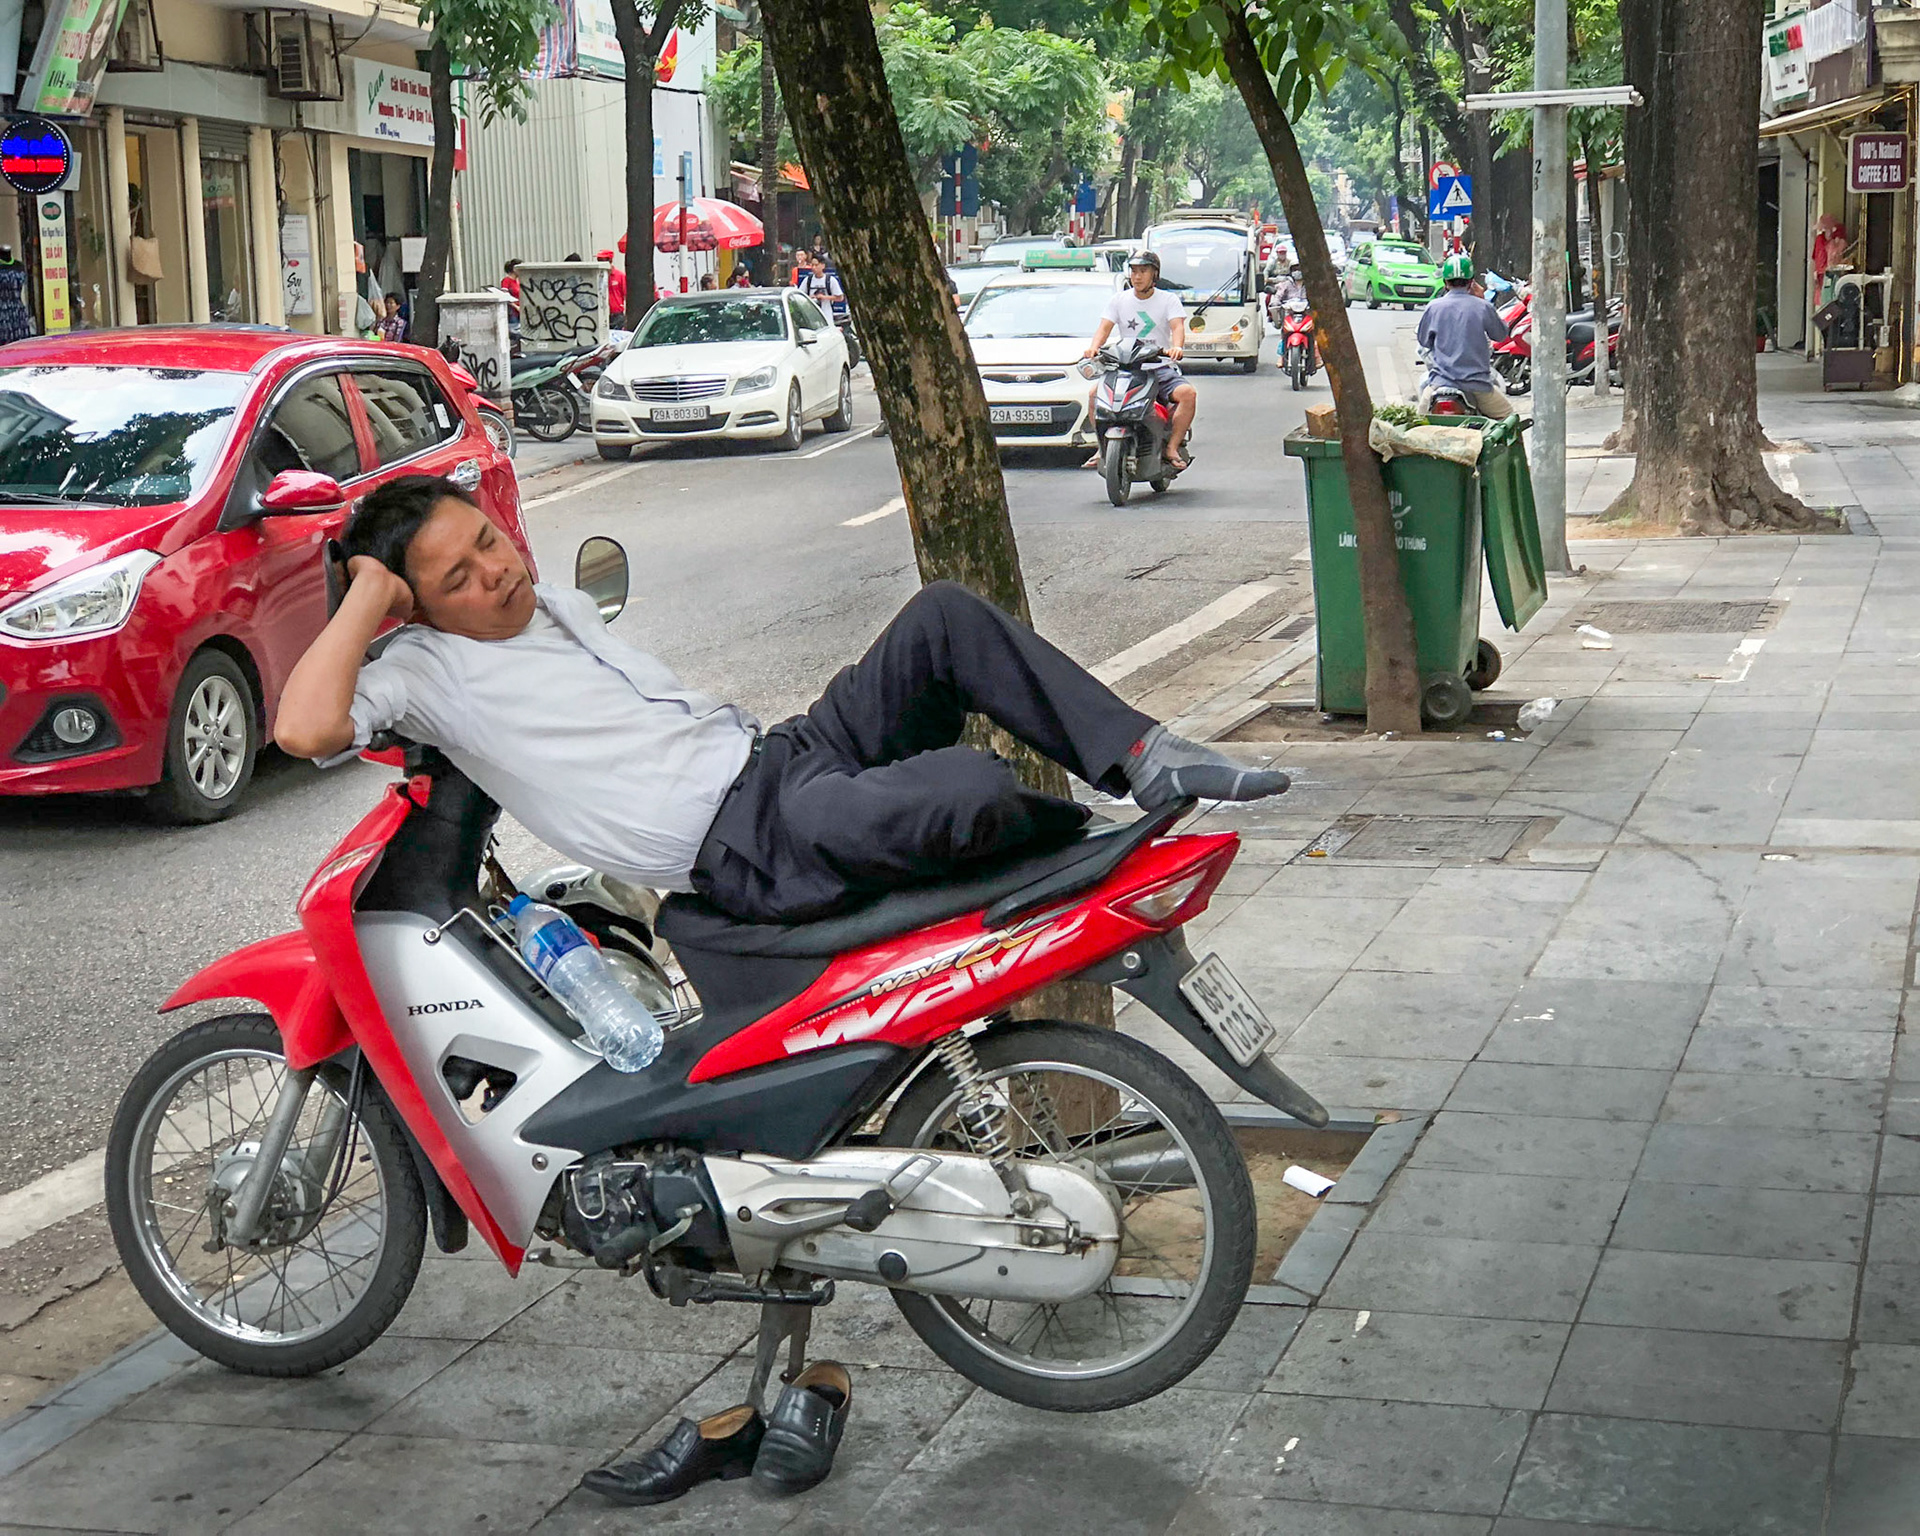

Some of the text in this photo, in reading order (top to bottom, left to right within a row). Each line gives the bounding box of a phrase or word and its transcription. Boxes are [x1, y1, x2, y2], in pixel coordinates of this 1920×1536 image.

[1859, 141, 1902, 160] 100% Natural
[1858, 164, 1902, 184] COFFEE & TEA
[653, 407, 705, 421] 29A-803.90
[992, 409, 1050, 422] 29A-935.59
[407, 998, 484, 1016] HONDA
